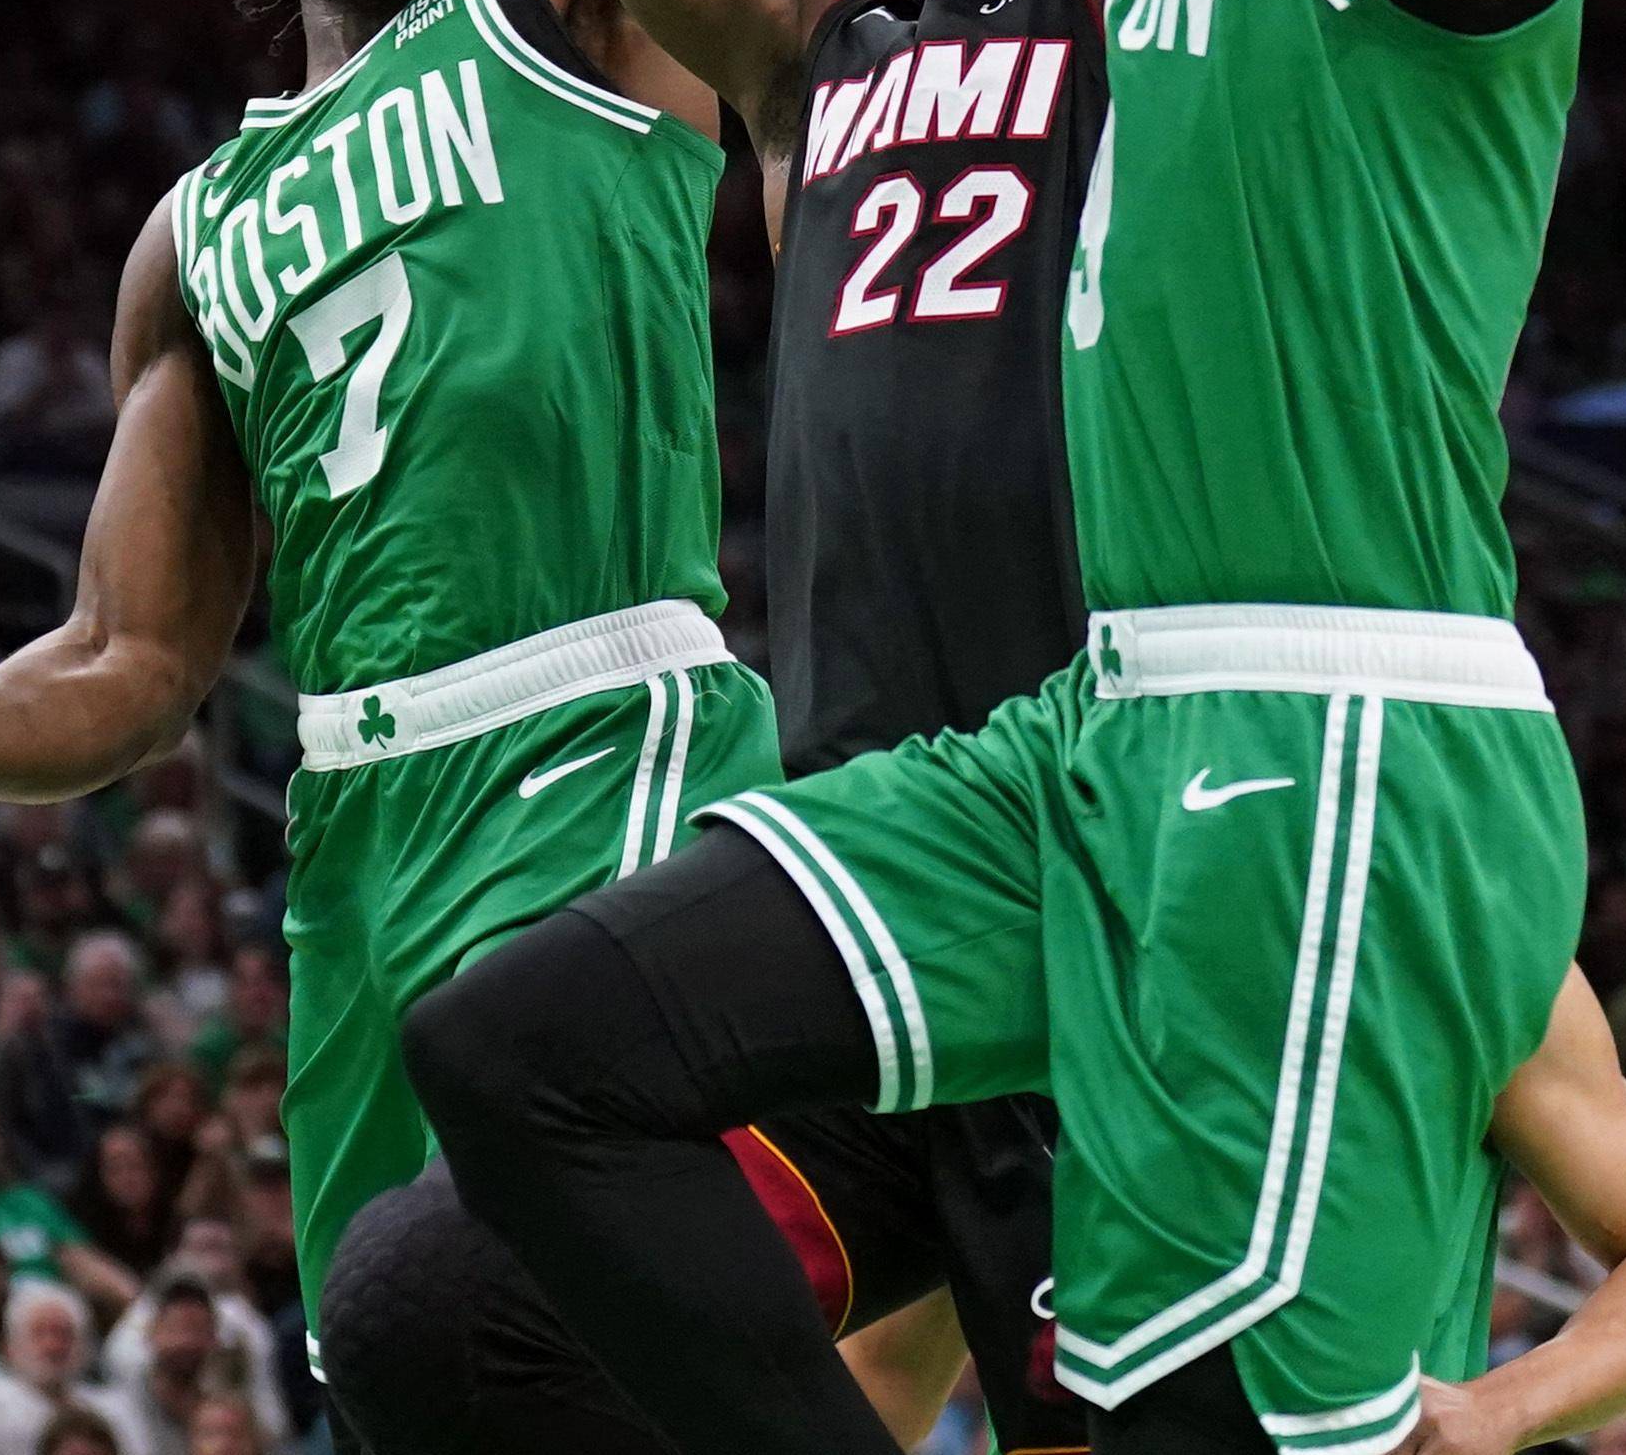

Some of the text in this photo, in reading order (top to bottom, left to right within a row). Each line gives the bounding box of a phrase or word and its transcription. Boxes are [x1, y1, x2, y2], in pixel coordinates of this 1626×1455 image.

[187, 59, 505, 393] BOSTON
[827, 162, 1036, 339] 22
[286, 250, 413, 500] 7
